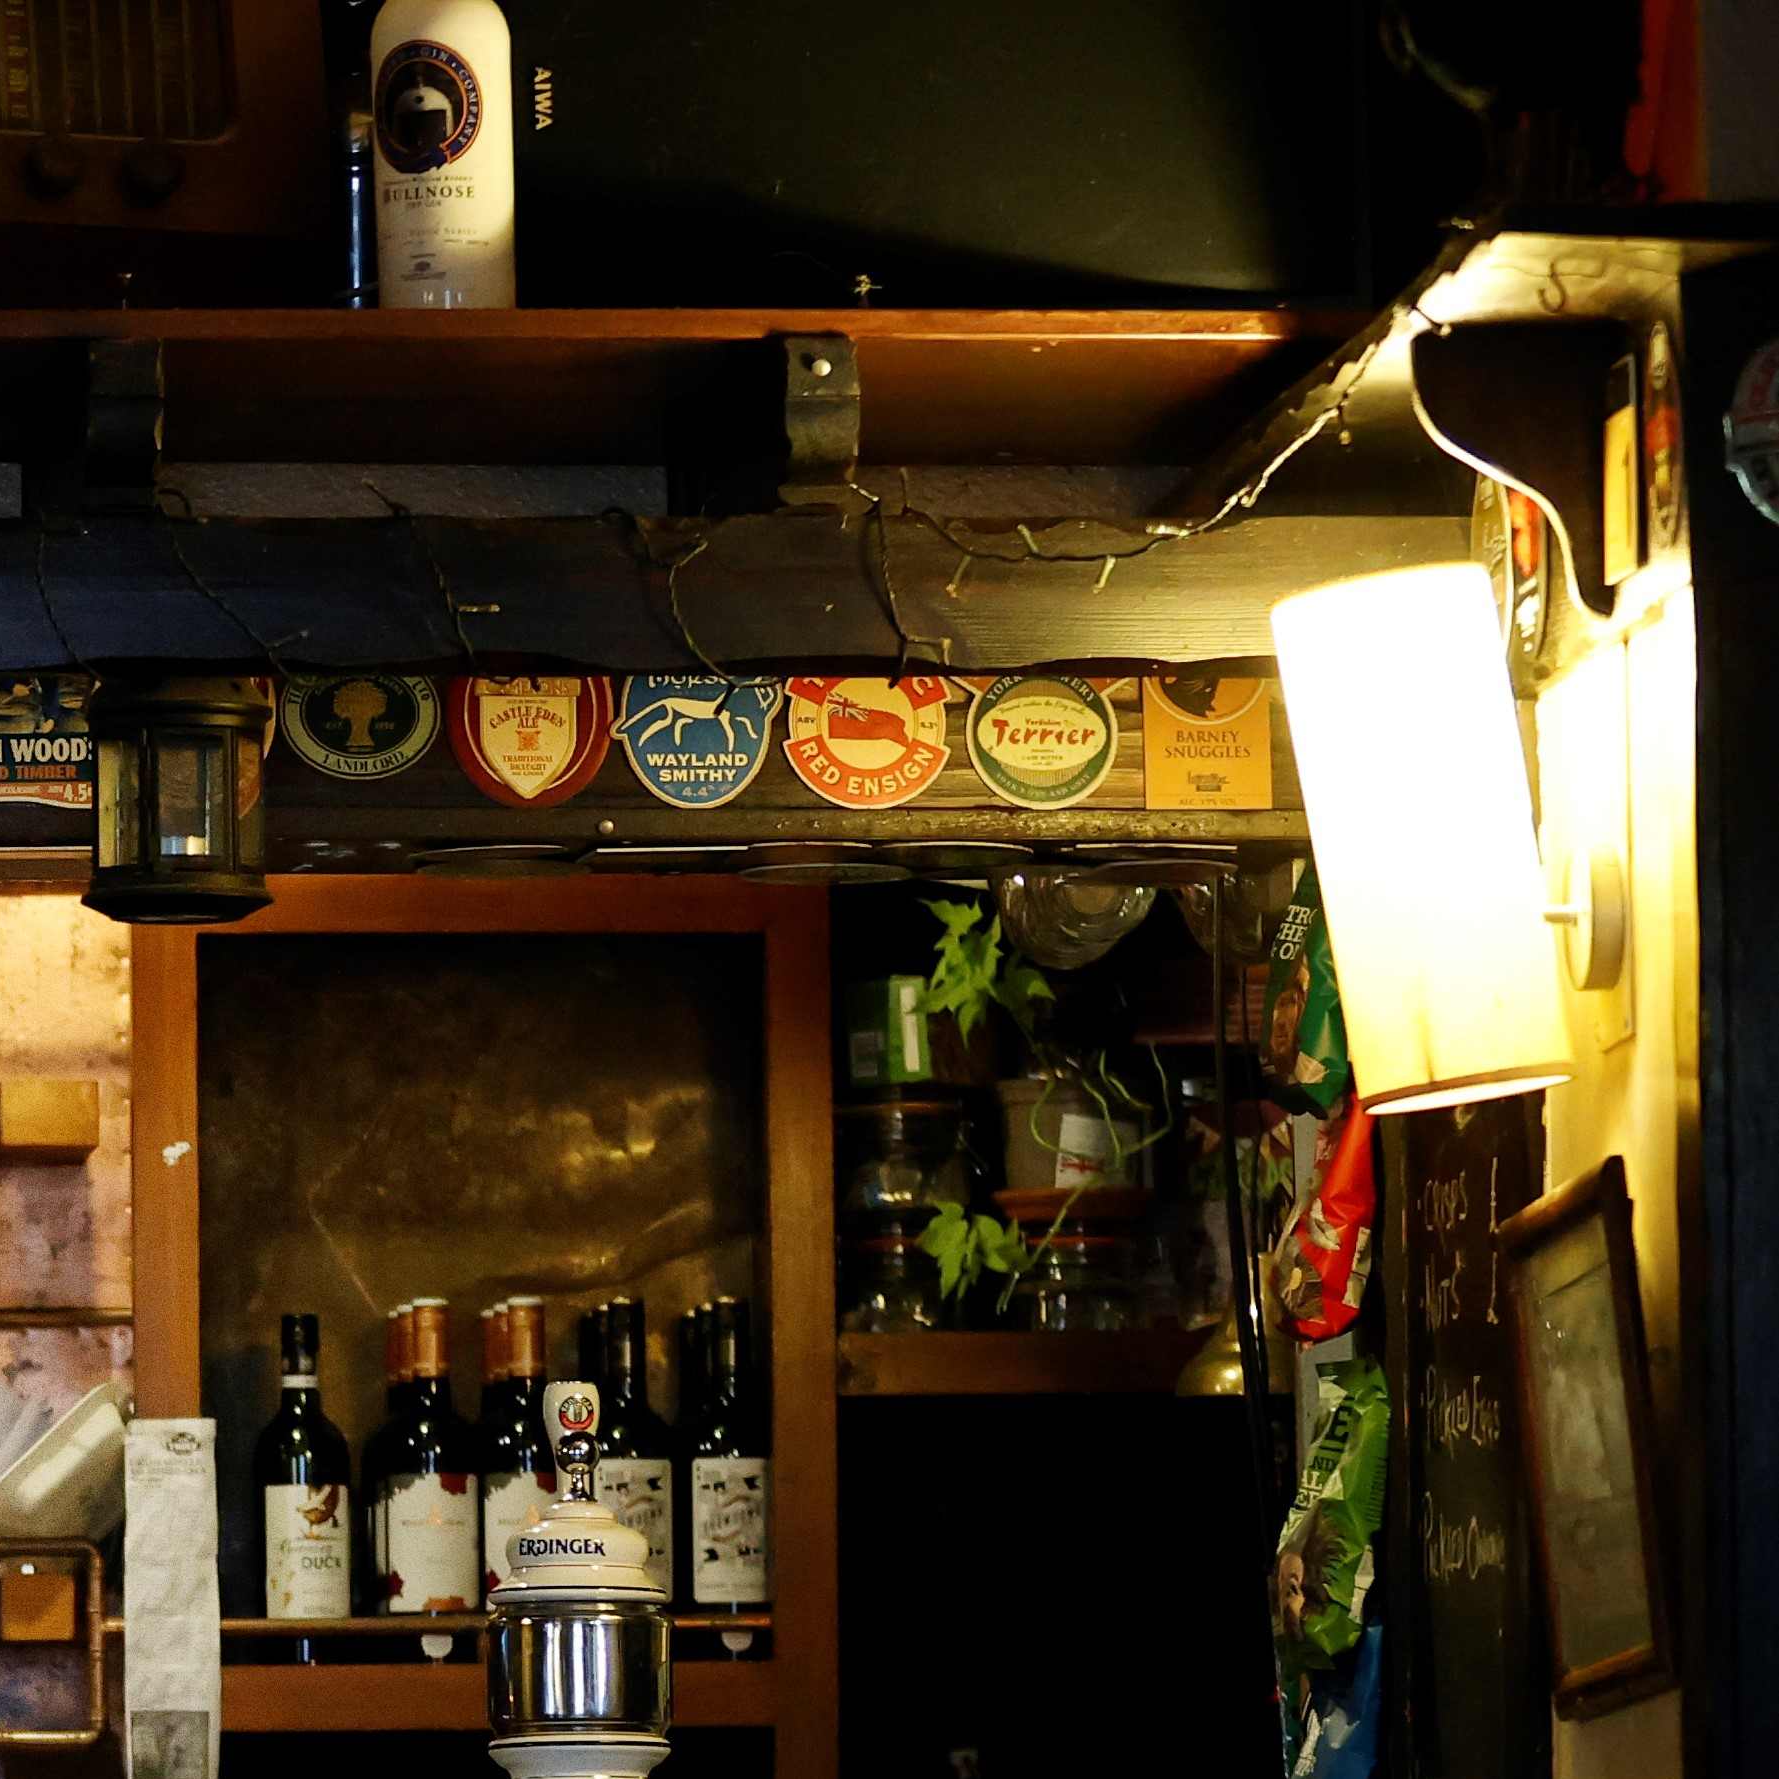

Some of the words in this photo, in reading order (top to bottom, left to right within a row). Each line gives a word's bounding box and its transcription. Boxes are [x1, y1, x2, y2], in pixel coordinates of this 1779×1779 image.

[458, 66, 480, 145] COMPANY
[534, 66, 553, 130] AIWA
[490, 706, 533, 729] CASTLE
[534, 707, 567, 728] EDEN
[516, 716, 539, 730] ALE
[991, 717, 1097, 747] Terrier
[1175, 729, 1240, 744] BARNEY
[502, 754, 554, 764] TRADITIONAL
[647, 752, 749, 768] WAYLAND
[1164, 745, 1251, 760] SNUGGLES
[15, 765, 79, 780] TIMBER
[659, 768, 737, 784] SMITHY
[797, 740, 843, 786] RED
[846, 746, 936, 798] ENSIGN
[518, 1537, 606, 1557] ERDINGER
